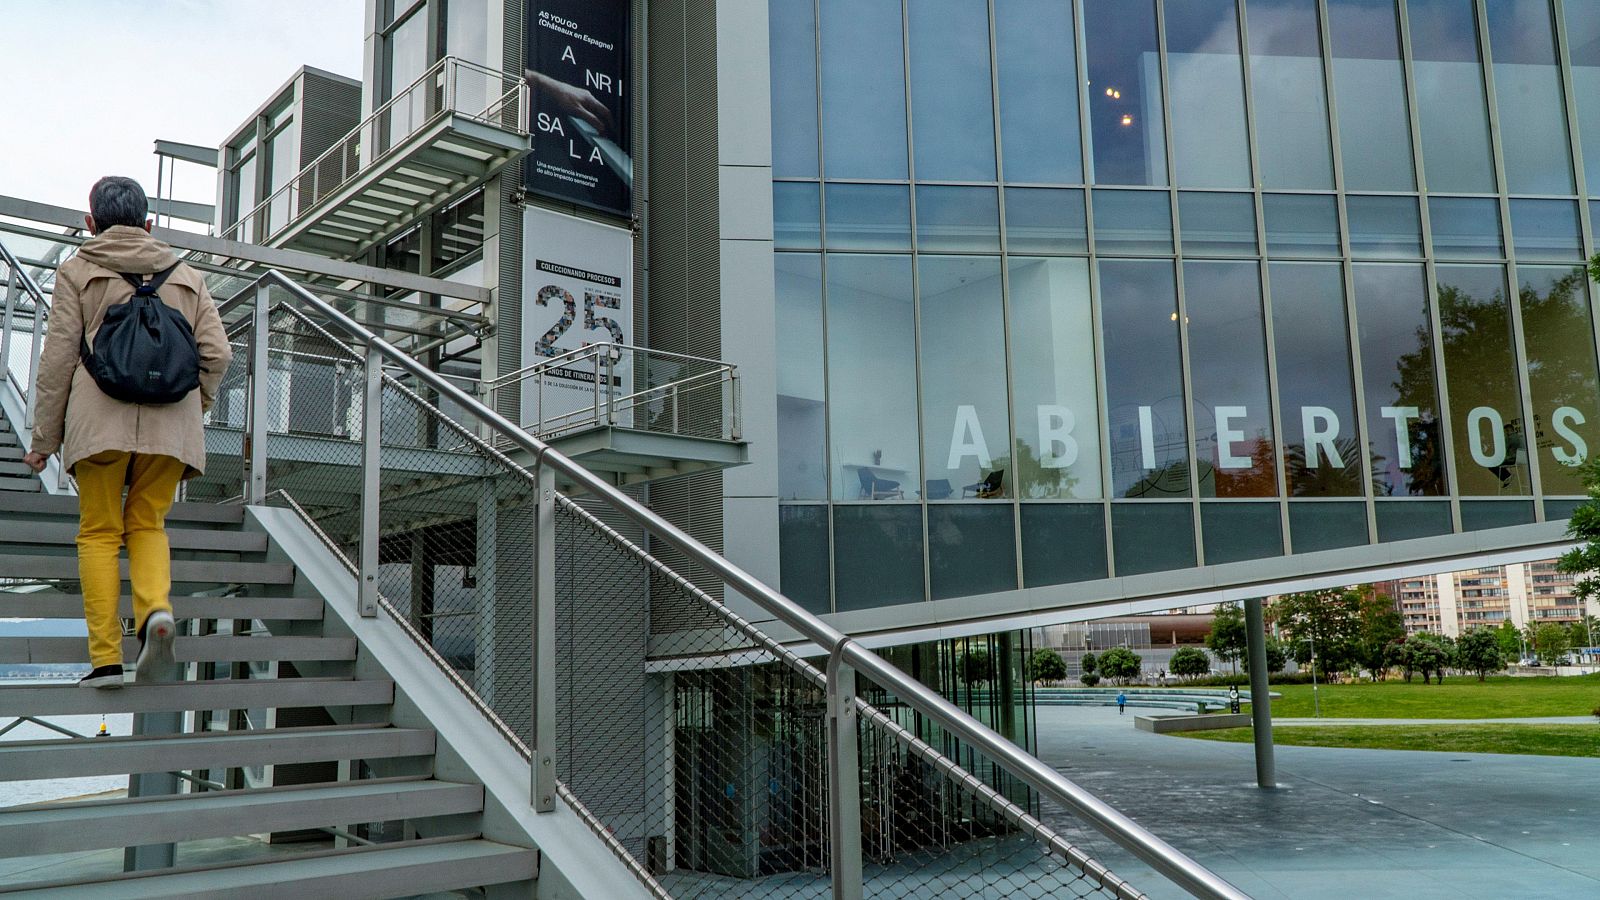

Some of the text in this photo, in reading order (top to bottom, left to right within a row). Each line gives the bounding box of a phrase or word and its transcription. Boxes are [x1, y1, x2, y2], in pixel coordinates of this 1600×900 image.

[538, 10, 578, 30] AS YOU GO
[538, 18, 614, 51] (Châteaux en Espagne)
[561, 45, 576, 65] A
[536, 160, 598, 183] Una experiencia inmersiva
[553, 172, 574, 182] impacto
[574, 178, 596, 188] sensorial
[540, 262, 616, 285] COLECCIONANDO PROCESOS
[535, 284, 623, 367] 25
[564, 370, 572, 378] DE
[946, 405, 1588, 469] ABIERTOS
